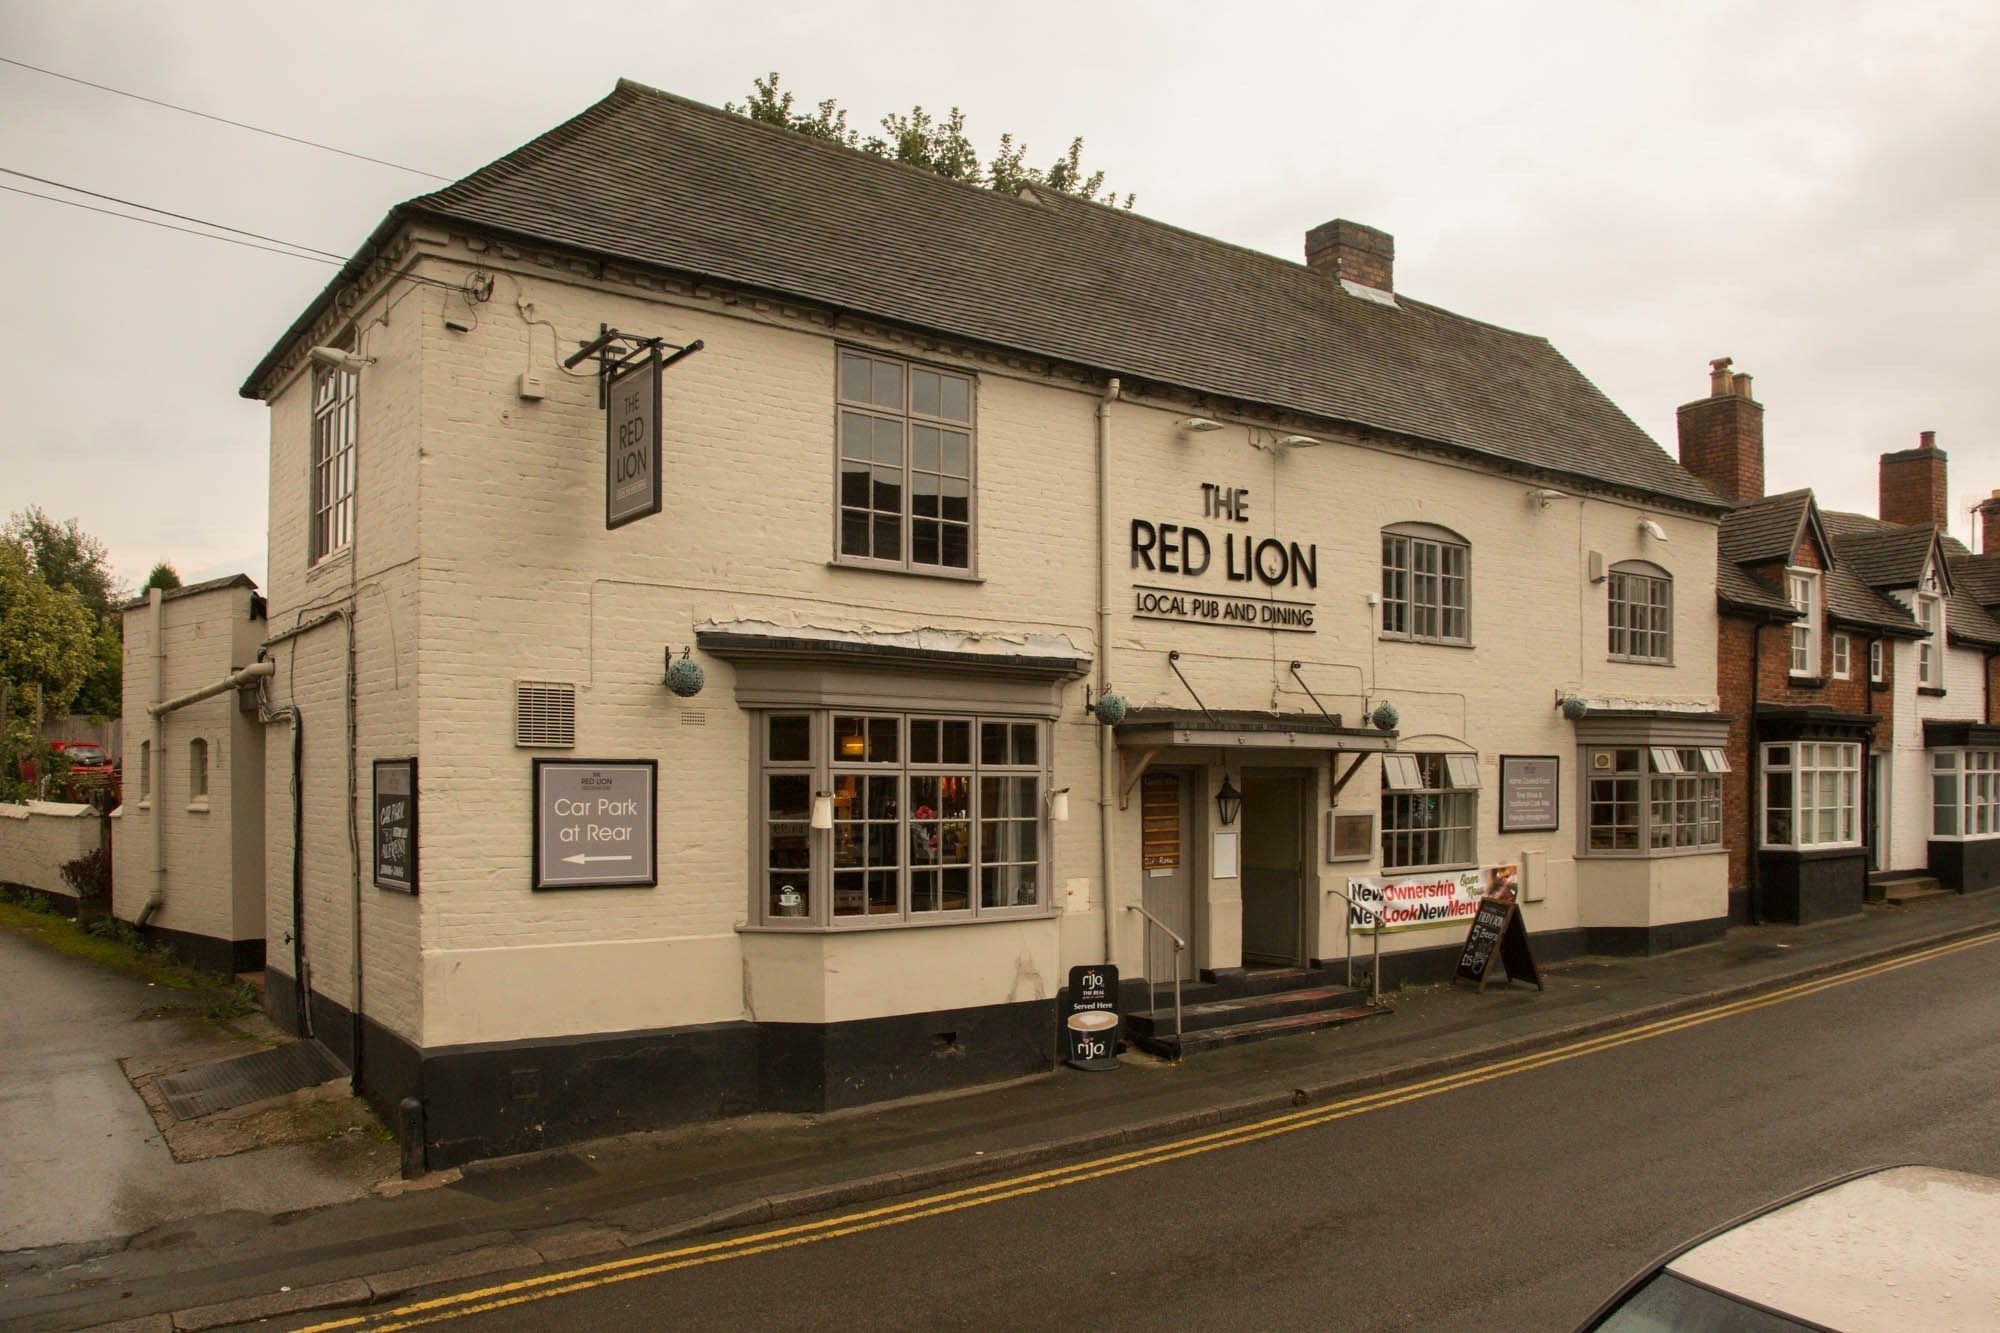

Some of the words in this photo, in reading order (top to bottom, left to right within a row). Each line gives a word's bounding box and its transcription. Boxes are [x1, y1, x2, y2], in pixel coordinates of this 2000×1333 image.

[624, 391, 640, 416] THE
[620, 416, 644, 450] RED
[617, 446, 647, 483] LION
[1201, 482, 1249, 522] THE
[1131, 518, 1211, 576] RED
[1225, 533, 1317, 589] LION
[1136, 592, 1188, 615] LOCAL
[1192, 598, 1219, 618] PUB
[1223, 602, 1257, 621] AND
[1261, 605, 1314, 626] DINING
[554, 798, 592, 816] Car
[598, 797, 638, 816] Park
[560, 824, 580, 842] at
[587, 824, 632, 841] Rear
[1472, 925, 1481, 940] 5
[1073, 1002, 1095, 1010] Served
[1096, 1001, 1113, 1009] Here
